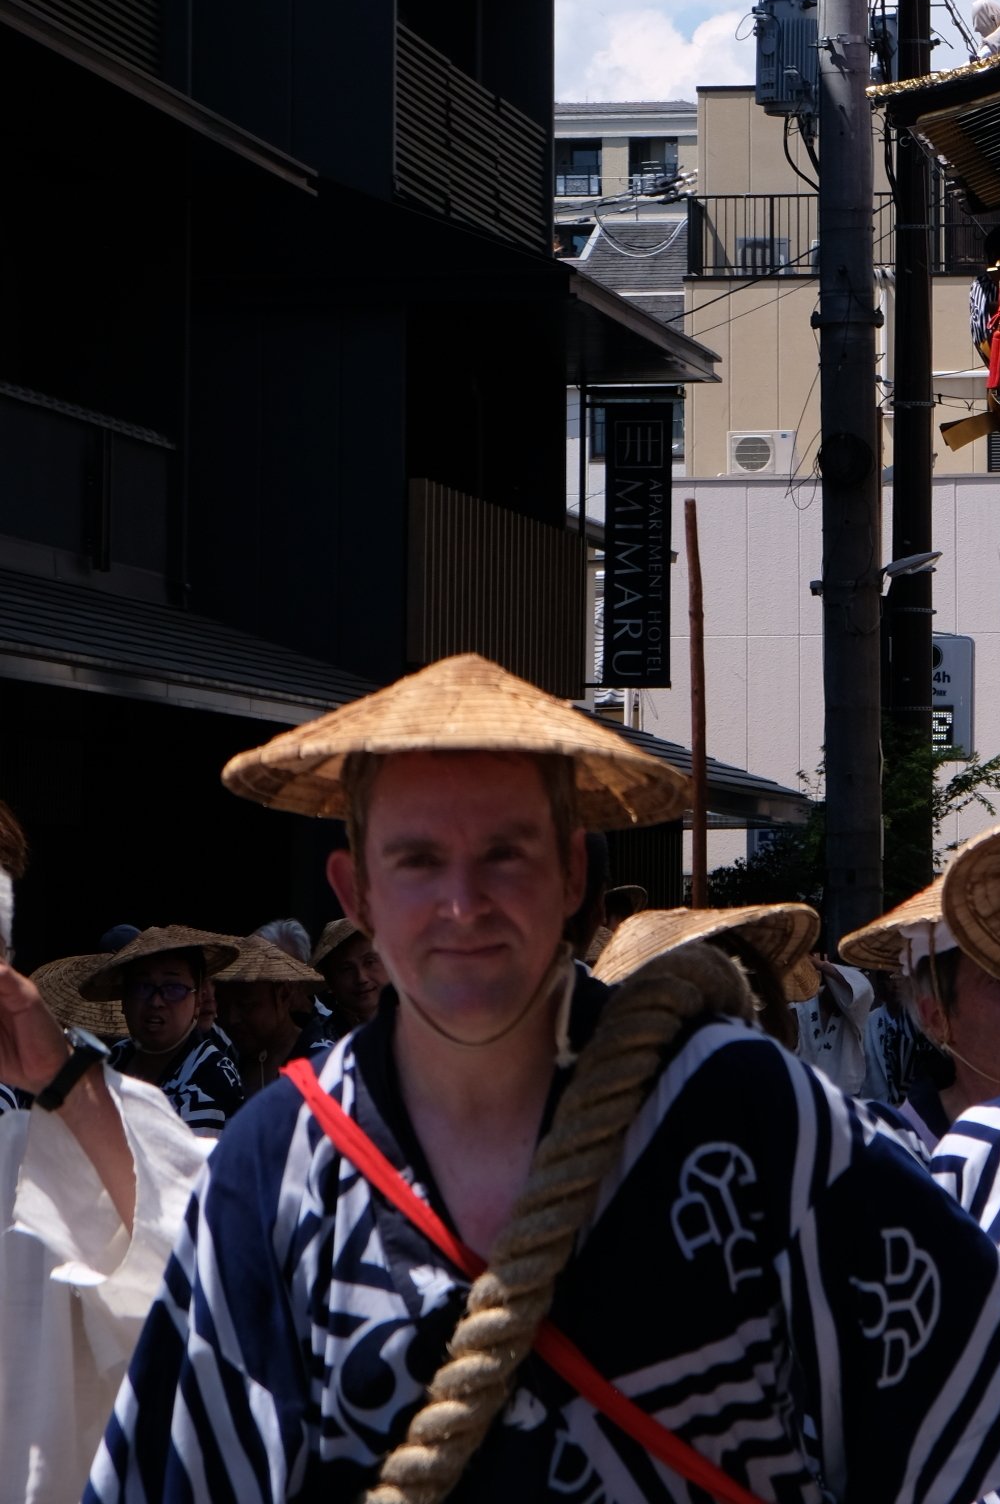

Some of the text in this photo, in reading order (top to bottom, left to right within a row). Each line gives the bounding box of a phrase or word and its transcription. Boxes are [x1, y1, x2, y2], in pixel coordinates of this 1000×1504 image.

[612, 478, 644, 677] MIMARU
[646, 479, 663, 676] APARTMENT HOTEL
[932, 670, 951, 683] 4h
